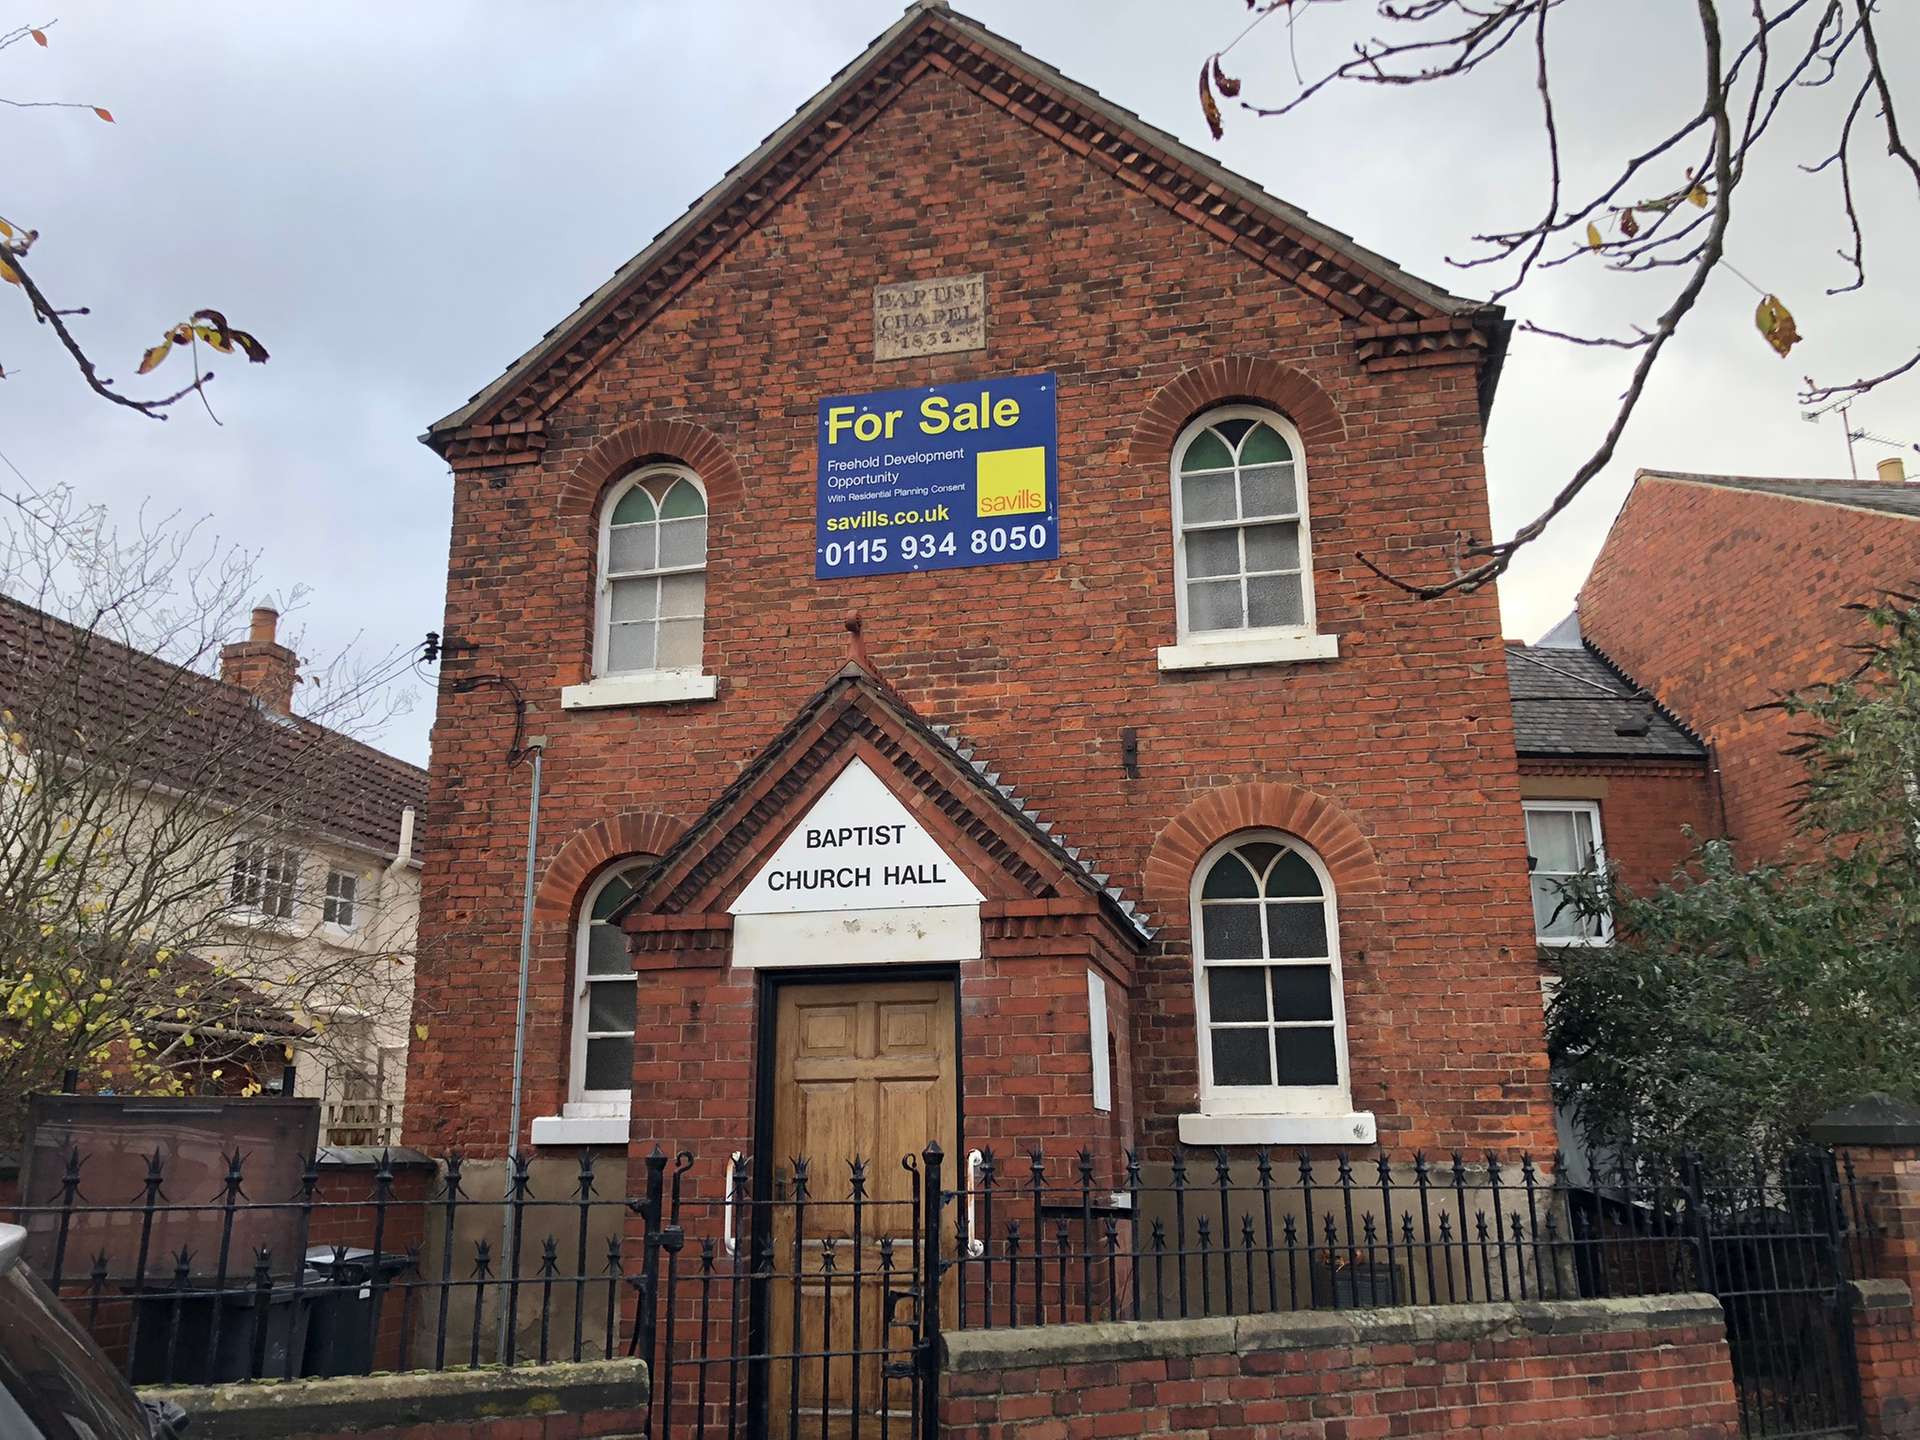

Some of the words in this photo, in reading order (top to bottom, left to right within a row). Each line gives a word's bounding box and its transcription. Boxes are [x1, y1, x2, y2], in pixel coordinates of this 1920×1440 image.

[828, 406, 903, 444] For
[919, 392, 1020, 434] Sale
[827, 456, 880, 472] Freehold
[884, 448, 964, 466] Development
[827, 471, 899, 489] Opportunity
[828, 494, 846, 503] With
[848, 489, 891, 502] Residential
[894, 487, 928, 498] Planning
[931, 482, 965, 493] Consent
[980, 490, 1042, 512] savills
[826, 504, 949, 531] savills.co.uk
[825, 538, 888, 566] 0115
[900, 532, 957, 560] 934
[970, 524, 1046, 554] 8050
[806, 825, 906, 849] BAPTIST
[767, 867, 871, 891] CHURCH
[884, 864, 946, 886] HALL
